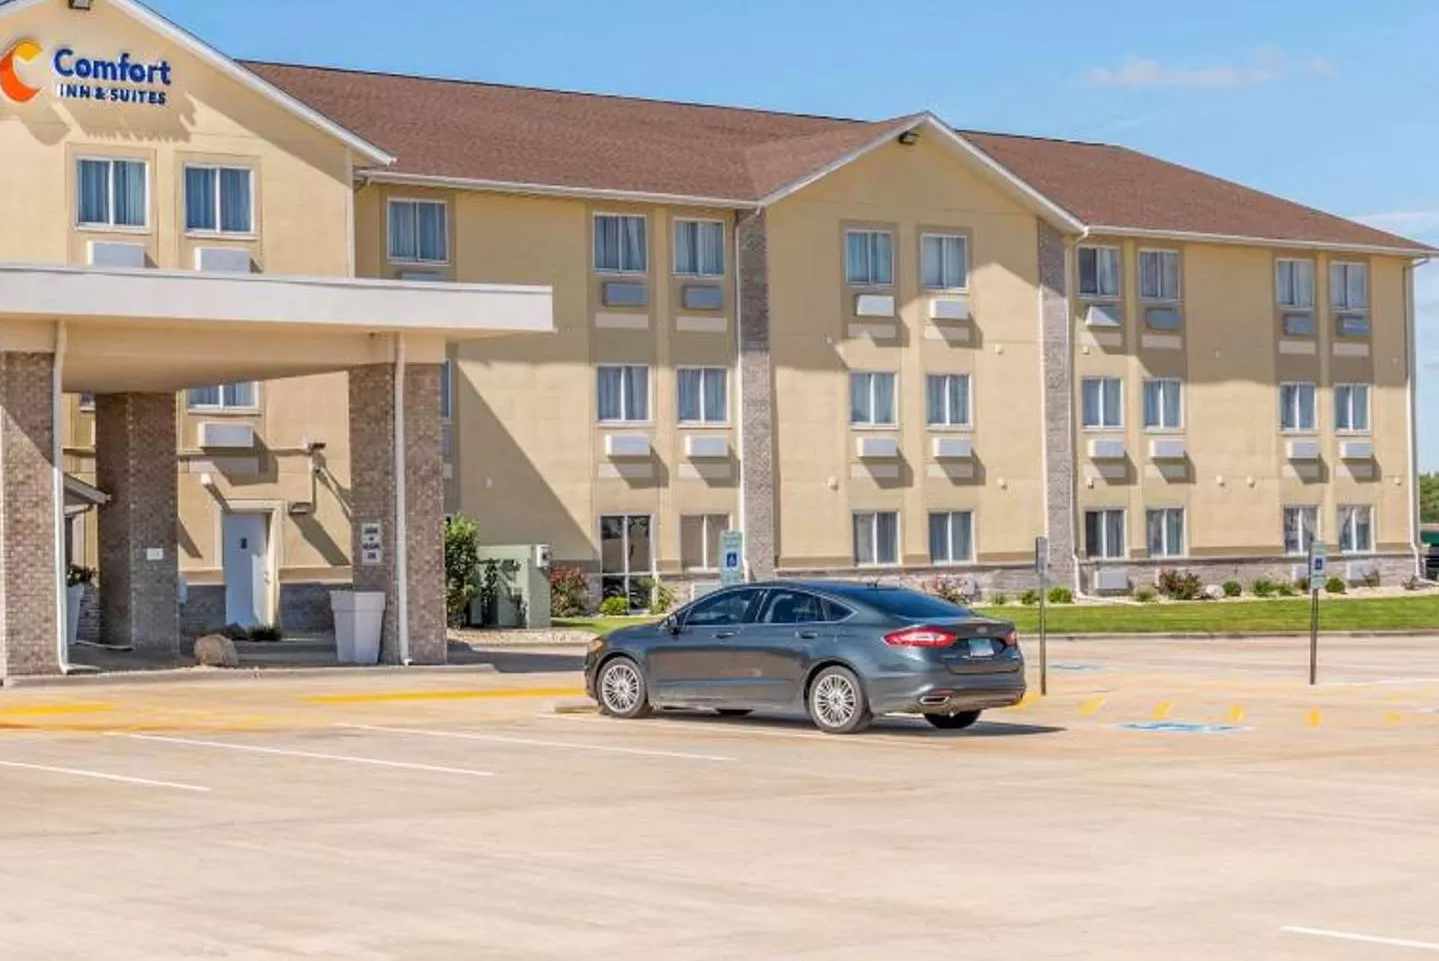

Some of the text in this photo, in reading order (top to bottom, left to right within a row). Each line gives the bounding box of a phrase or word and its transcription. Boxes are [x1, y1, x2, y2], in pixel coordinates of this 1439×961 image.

[53, 48, 172, 85] Comfort
[60, 84, 167, 105] INN & SUITES
